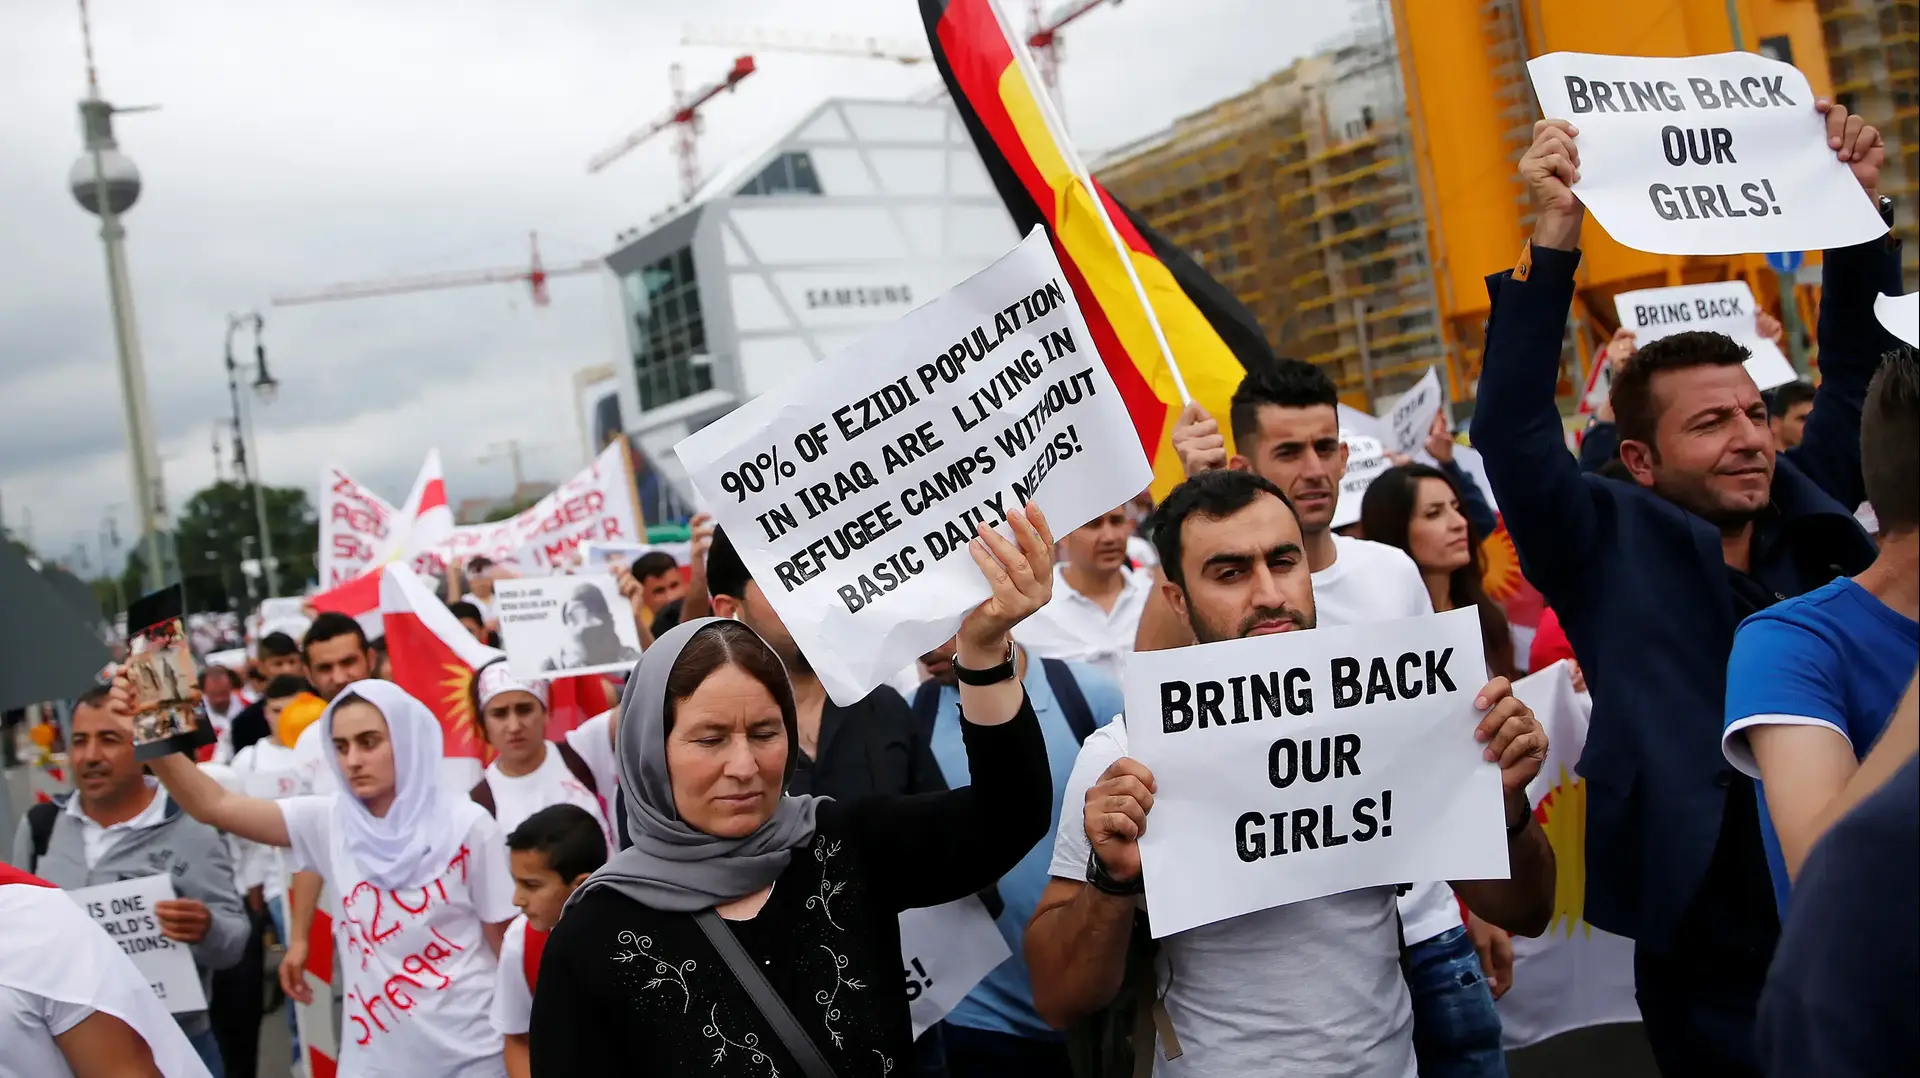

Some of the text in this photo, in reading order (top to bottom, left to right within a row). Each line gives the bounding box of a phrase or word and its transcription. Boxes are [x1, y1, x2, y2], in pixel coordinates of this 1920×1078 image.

[1564, 76, 1796, 114] BRING BACK
[1661, 125, 1737, 166] OUR
[1649, 179, 1782, 220] GIRLS!
[805, 285, 912, 310] SAMSUNG
[1636, 297, 1744, 326] BRING BACK
[720, 278, 1065, 503] 90% OF EZIDI POPULATION
[755, 327, 1077, 543] IN IRAQ ARE LIVING IN
[774, 367, 1097, 592] REFUGEE CAMPS WITHOUT
[837, 425, 1083, 614] BASIC DAILY NEEDS!
[1160, 648, 1457, 733] BRING BACK
[1267, 733, 1361, 789] OUR
[1235, 790, 1392, 862] GIRLS!
[87, 896, 146, 918] IS ONE
[103, 916, 155, 935] RLD'S
